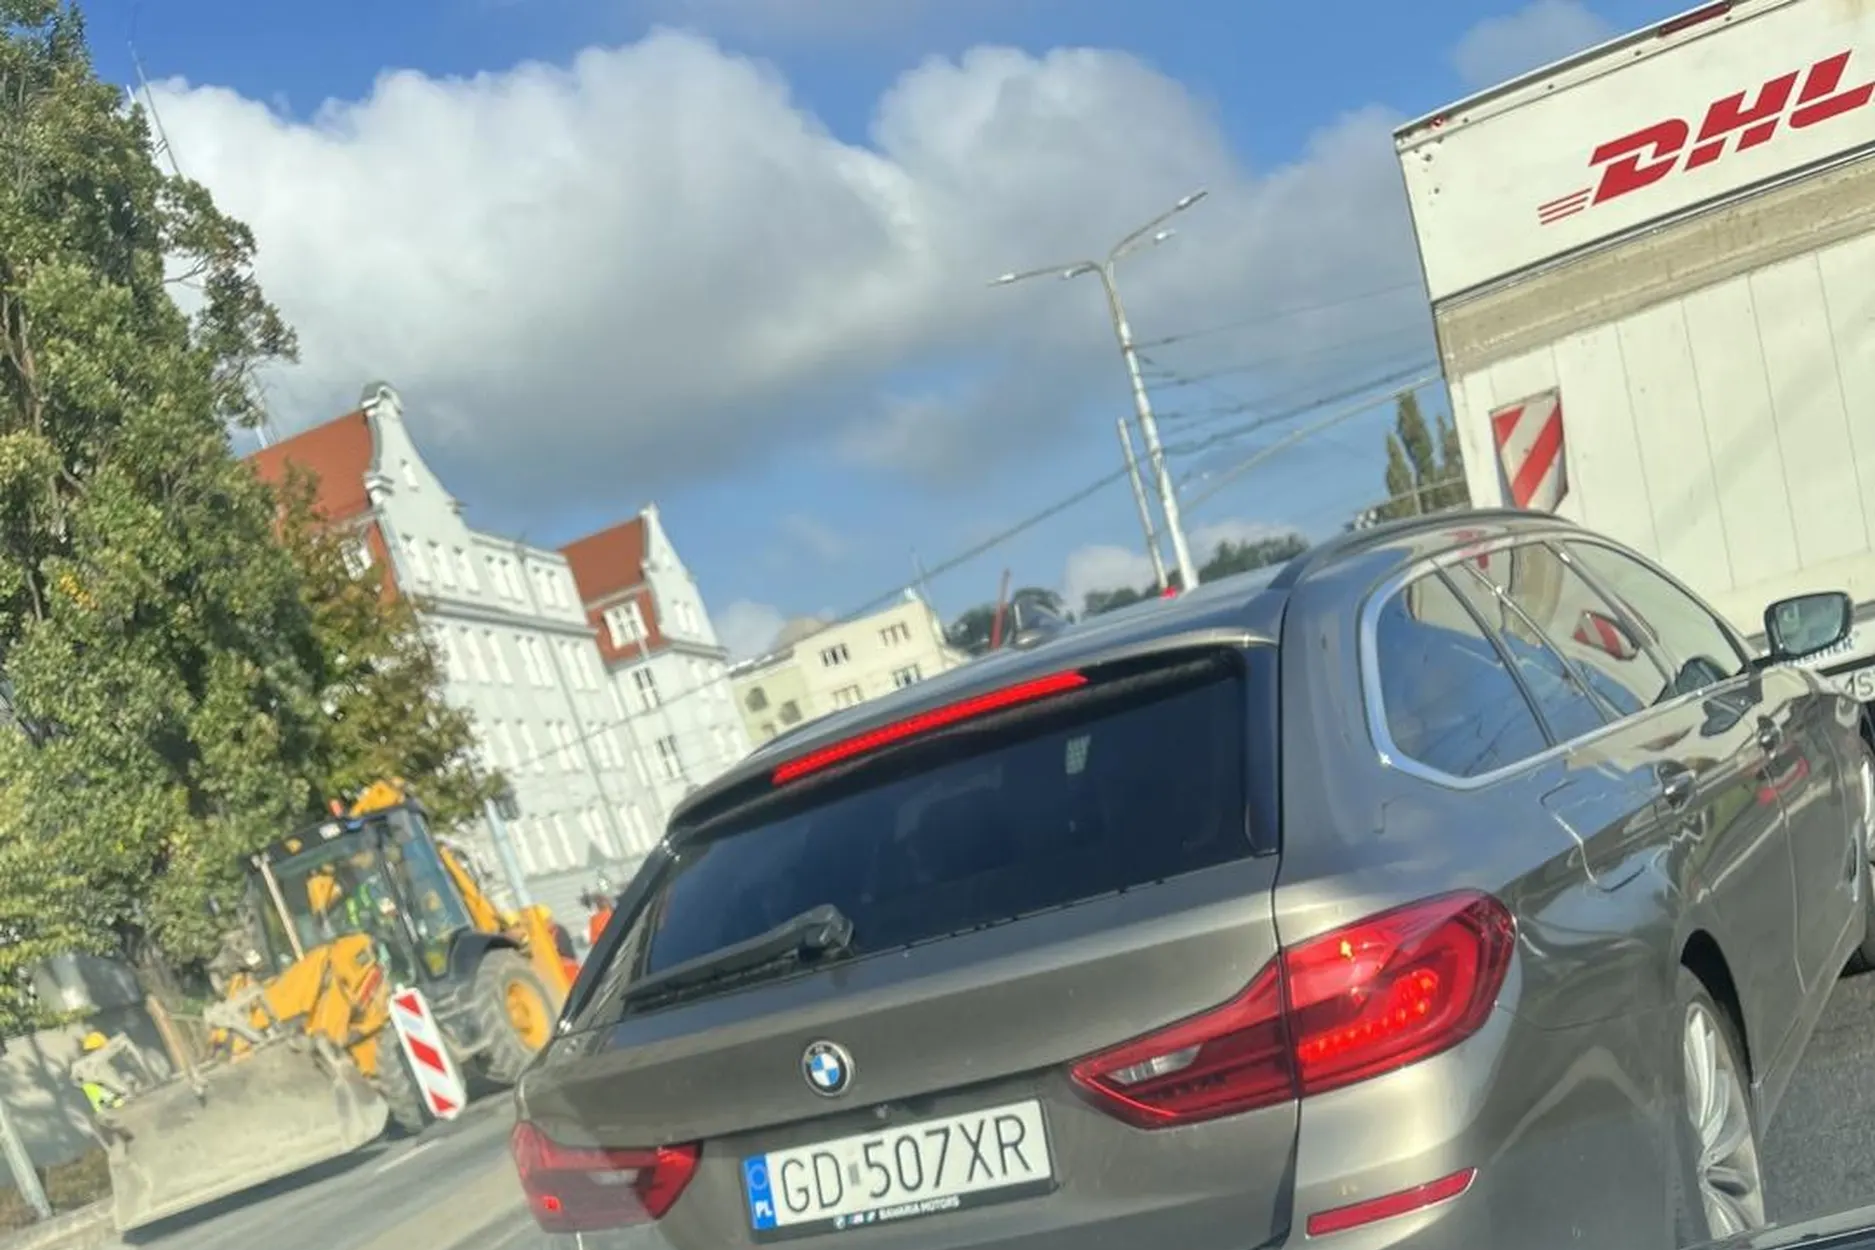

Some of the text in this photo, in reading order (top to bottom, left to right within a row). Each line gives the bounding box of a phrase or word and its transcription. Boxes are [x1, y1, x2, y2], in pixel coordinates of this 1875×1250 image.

[1588, 49, 1875, 207] DHL
[755, 1199, 773, 1218] PL
[780, 1113, 1032, 1213] GD 507XR
